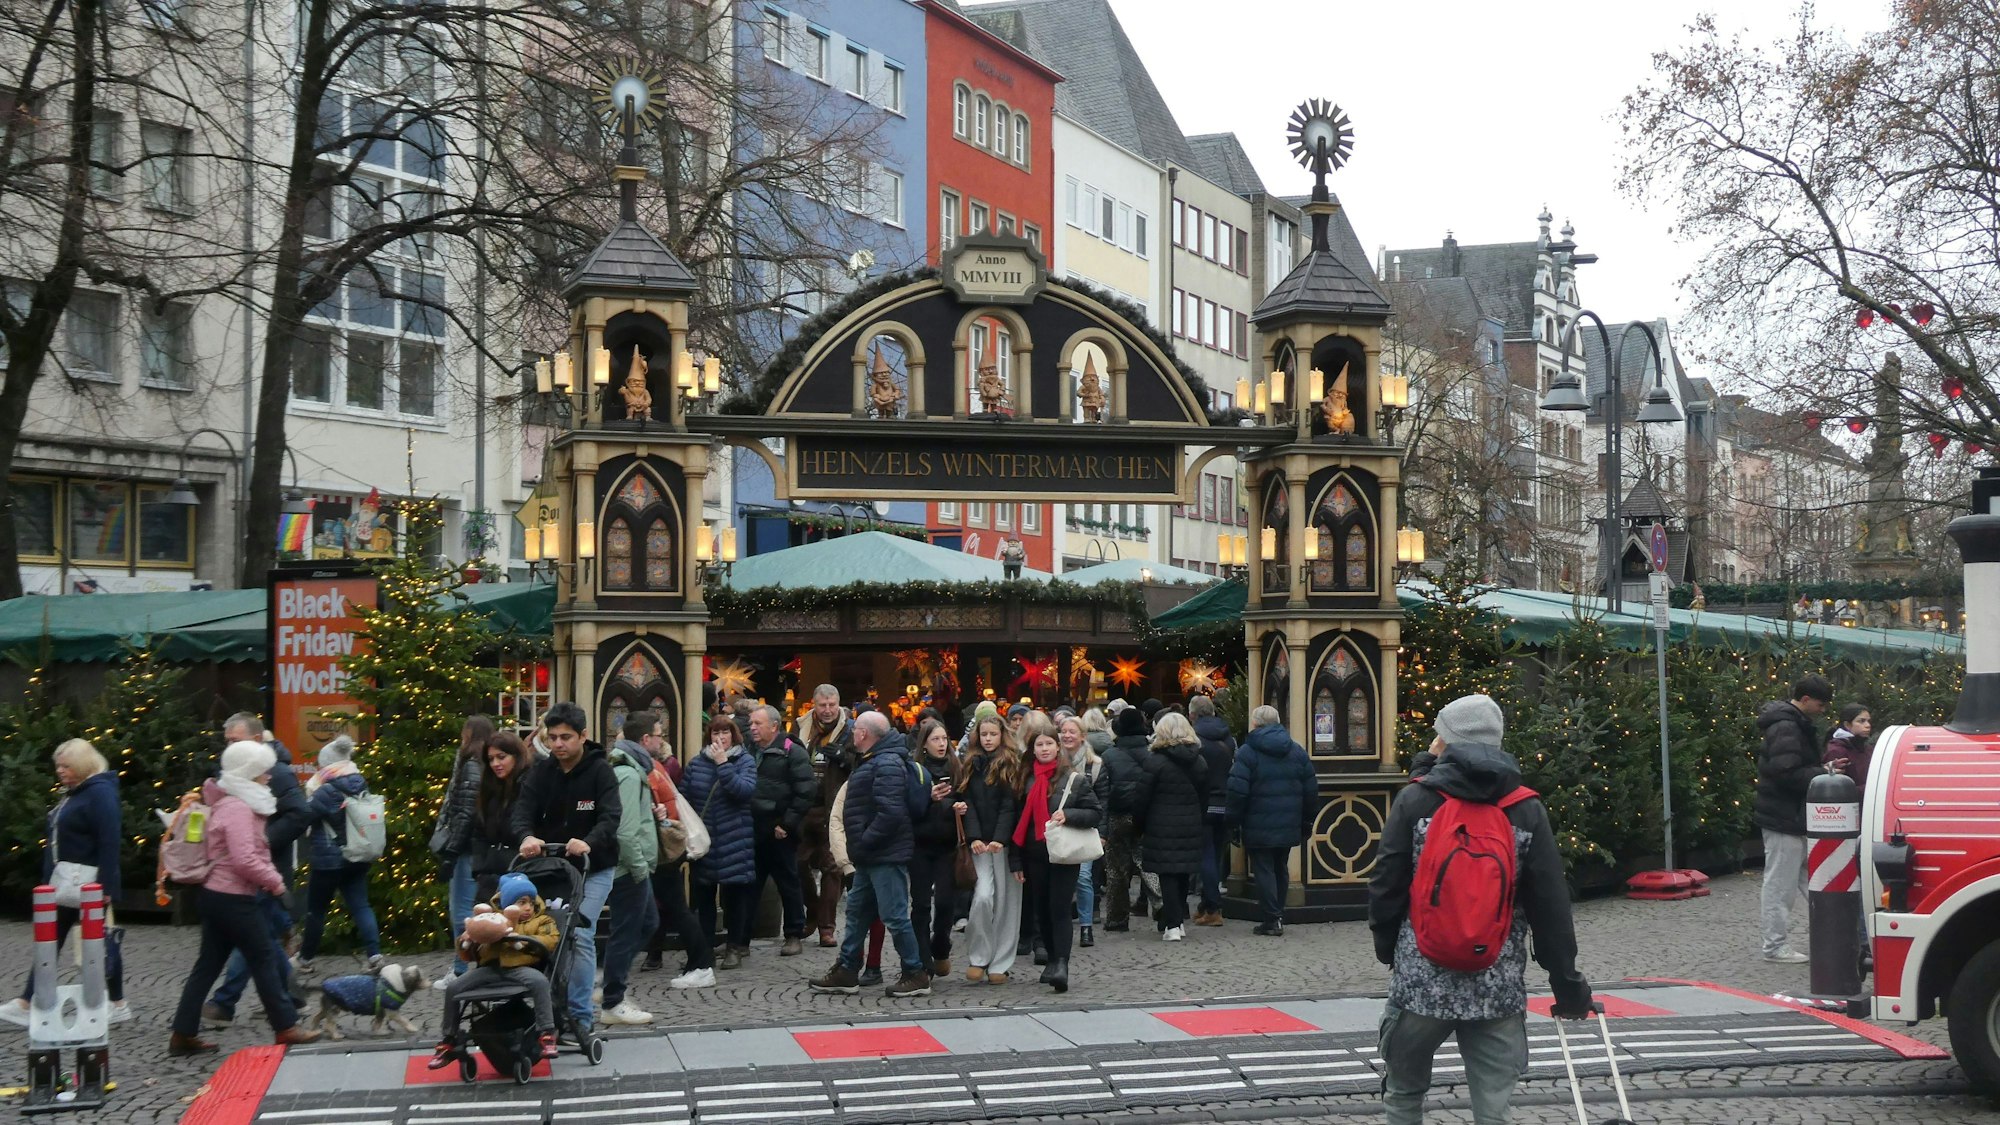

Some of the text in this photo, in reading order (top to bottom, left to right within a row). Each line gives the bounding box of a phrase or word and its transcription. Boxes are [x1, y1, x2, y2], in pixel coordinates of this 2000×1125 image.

[975, 254, 1007, 265] Anno
[960, 270, 1022, 284] MMVIII
[801, 450, 1172, 480] HEINZELS WINTERMÄRCHEN
[279, 587, 346, 619] Black
[278, 663, 352, 695] Woch
